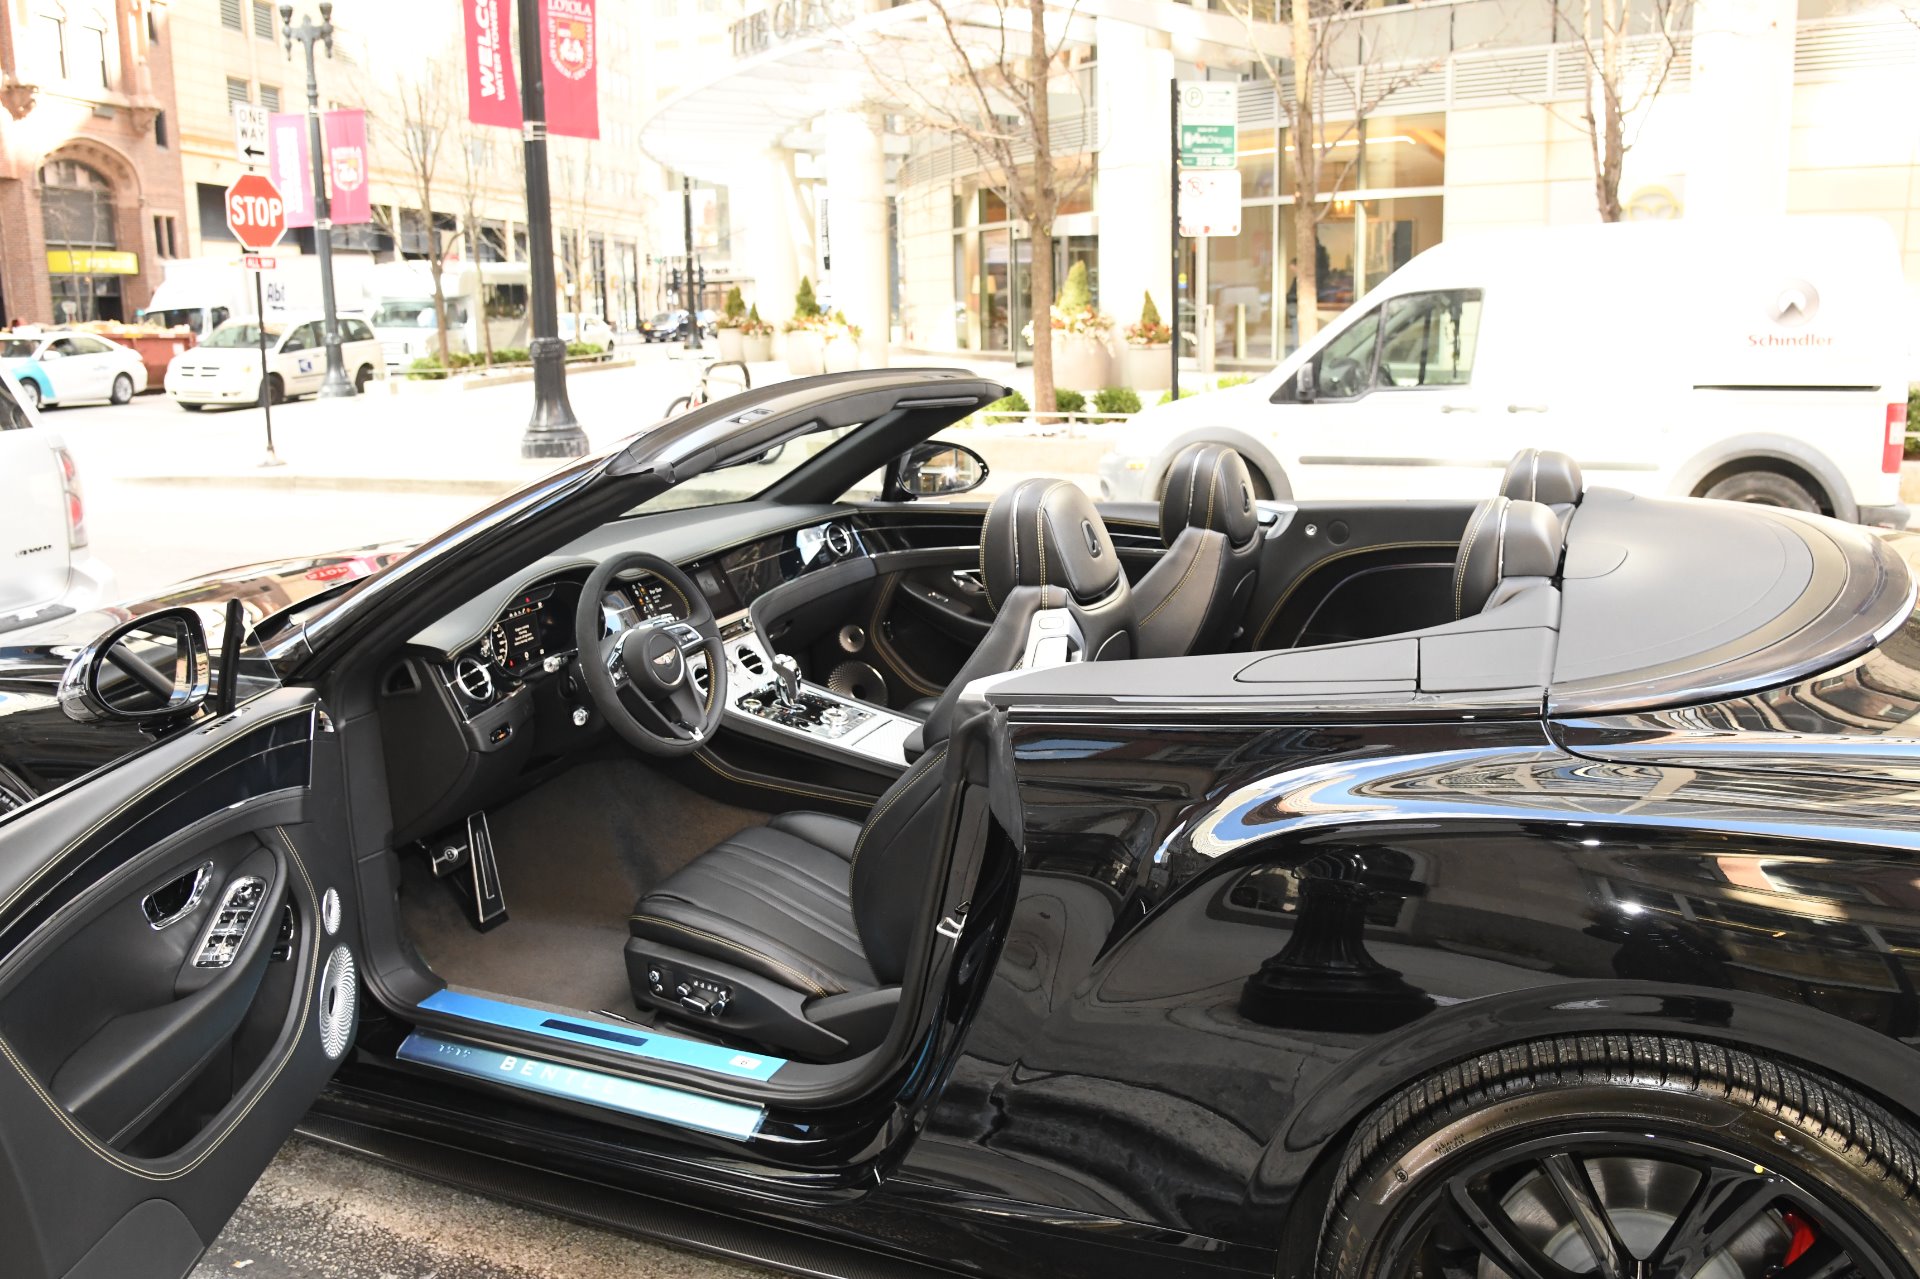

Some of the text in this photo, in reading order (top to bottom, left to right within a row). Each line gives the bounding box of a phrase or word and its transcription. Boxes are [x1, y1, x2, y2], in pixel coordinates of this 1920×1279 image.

[238, 108, 264, 126] ONE
[240, 123, 265, 141] WAY
[230, 194, 282, 228] STOP
[1748, 333, 1834, 347] Schindler
